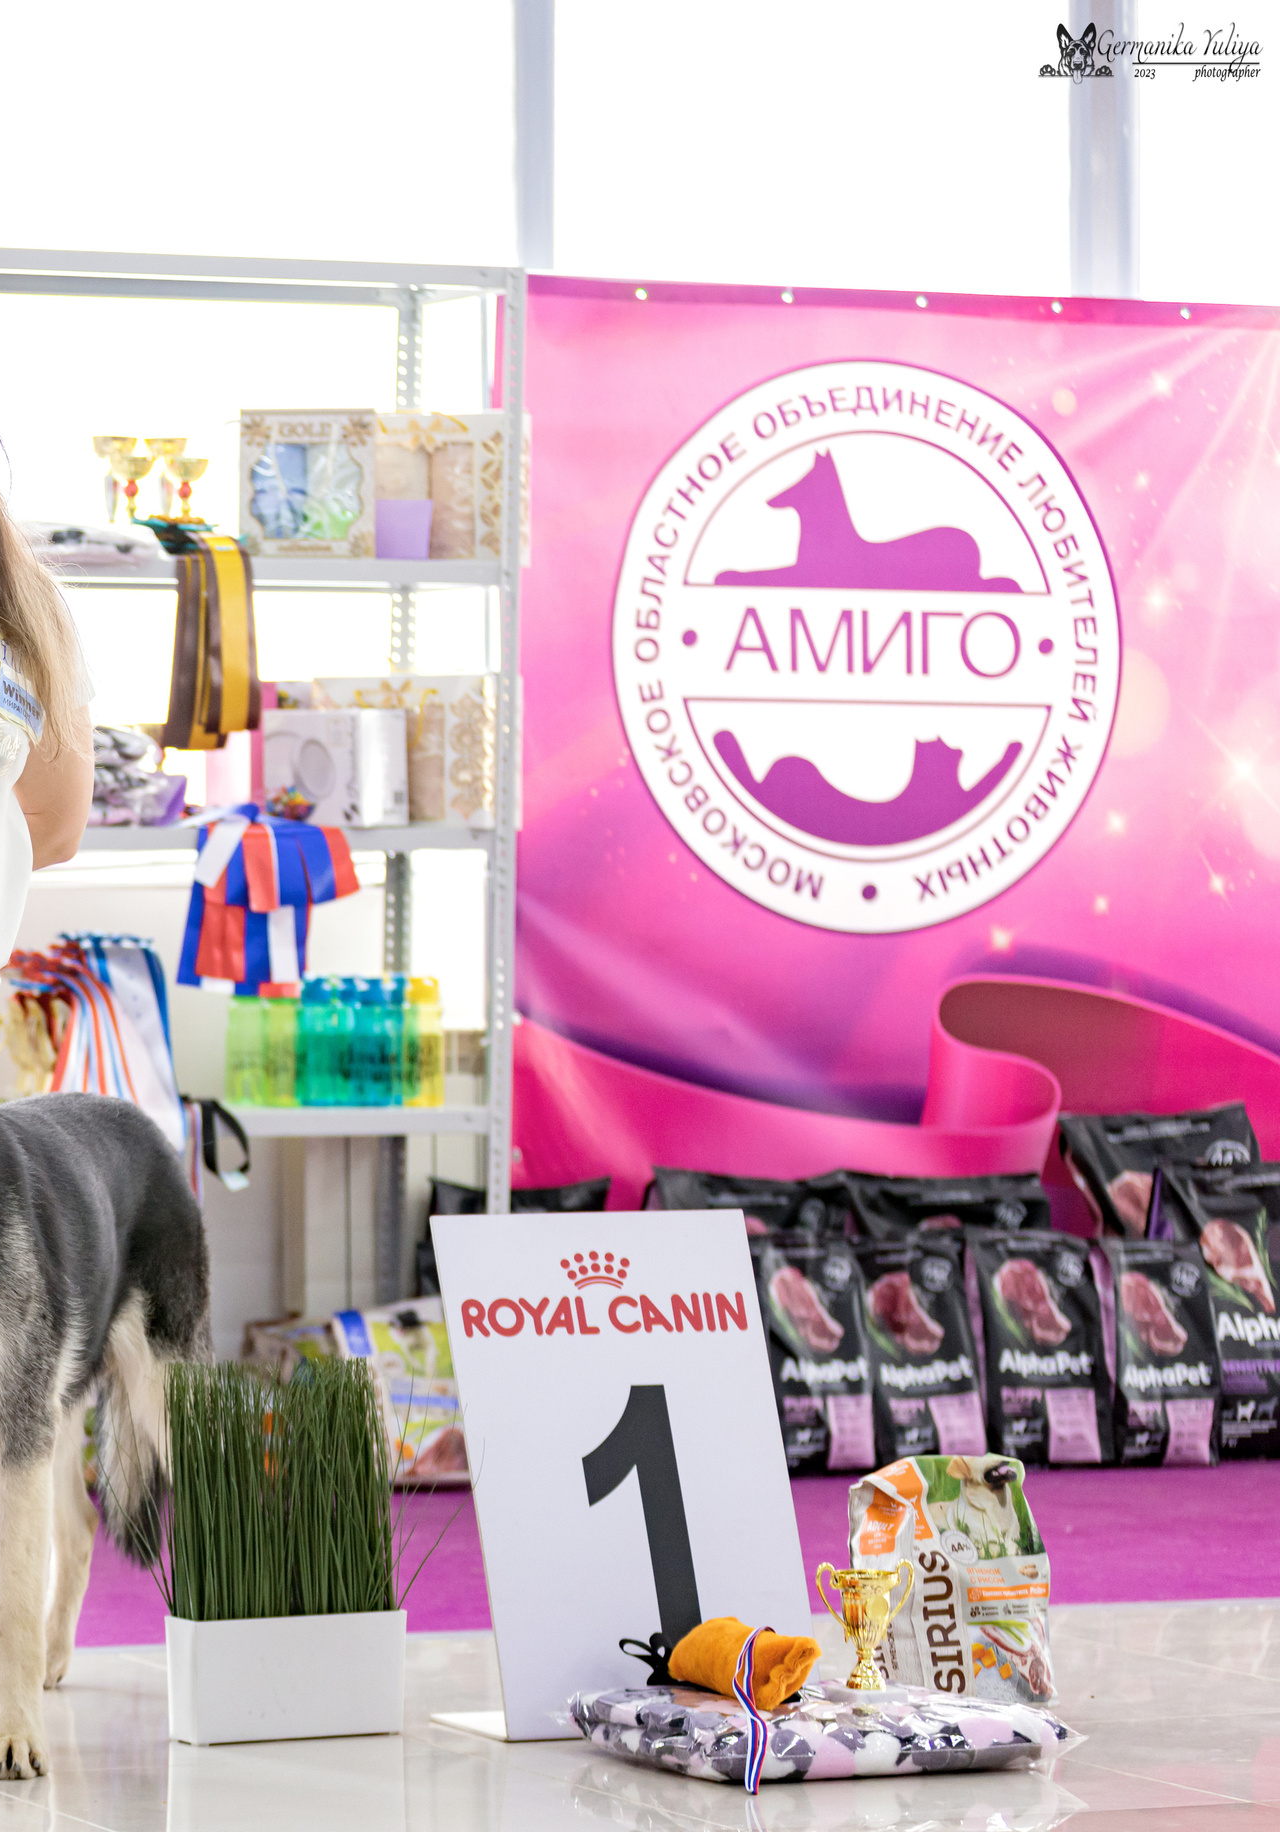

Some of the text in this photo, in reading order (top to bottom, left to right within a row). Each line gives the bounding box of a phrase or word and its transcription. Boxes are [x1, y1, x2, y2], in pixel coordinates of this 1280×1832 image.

[278, 423, 333, 437] GOLD
[633, 385, 1101, 904] МОСКОВСКОЕ ОБЛАСТНОЕ ОБЪЕДИНЕНИЕ ЛЮБИТЕЛЕЙ ЖИВОТНЫХ
[724, 606, 1023, 680] АМИГО
[461, 1291, 750, 1339] ROYAL CANIN
[781, 1357, 868, 1384] AlphaPet
[880, 1355, 973, 1390] AlphaPet
[999, 1348, 1093, 1379] AlphaPet
[1123, 1361, 1212, 1392] AlphaPet
[582, 1384, 701, 1646] 1
[867, 1521, 894, 1531] ADULT
[918, 1550, 966, 1694] SIRIUS
